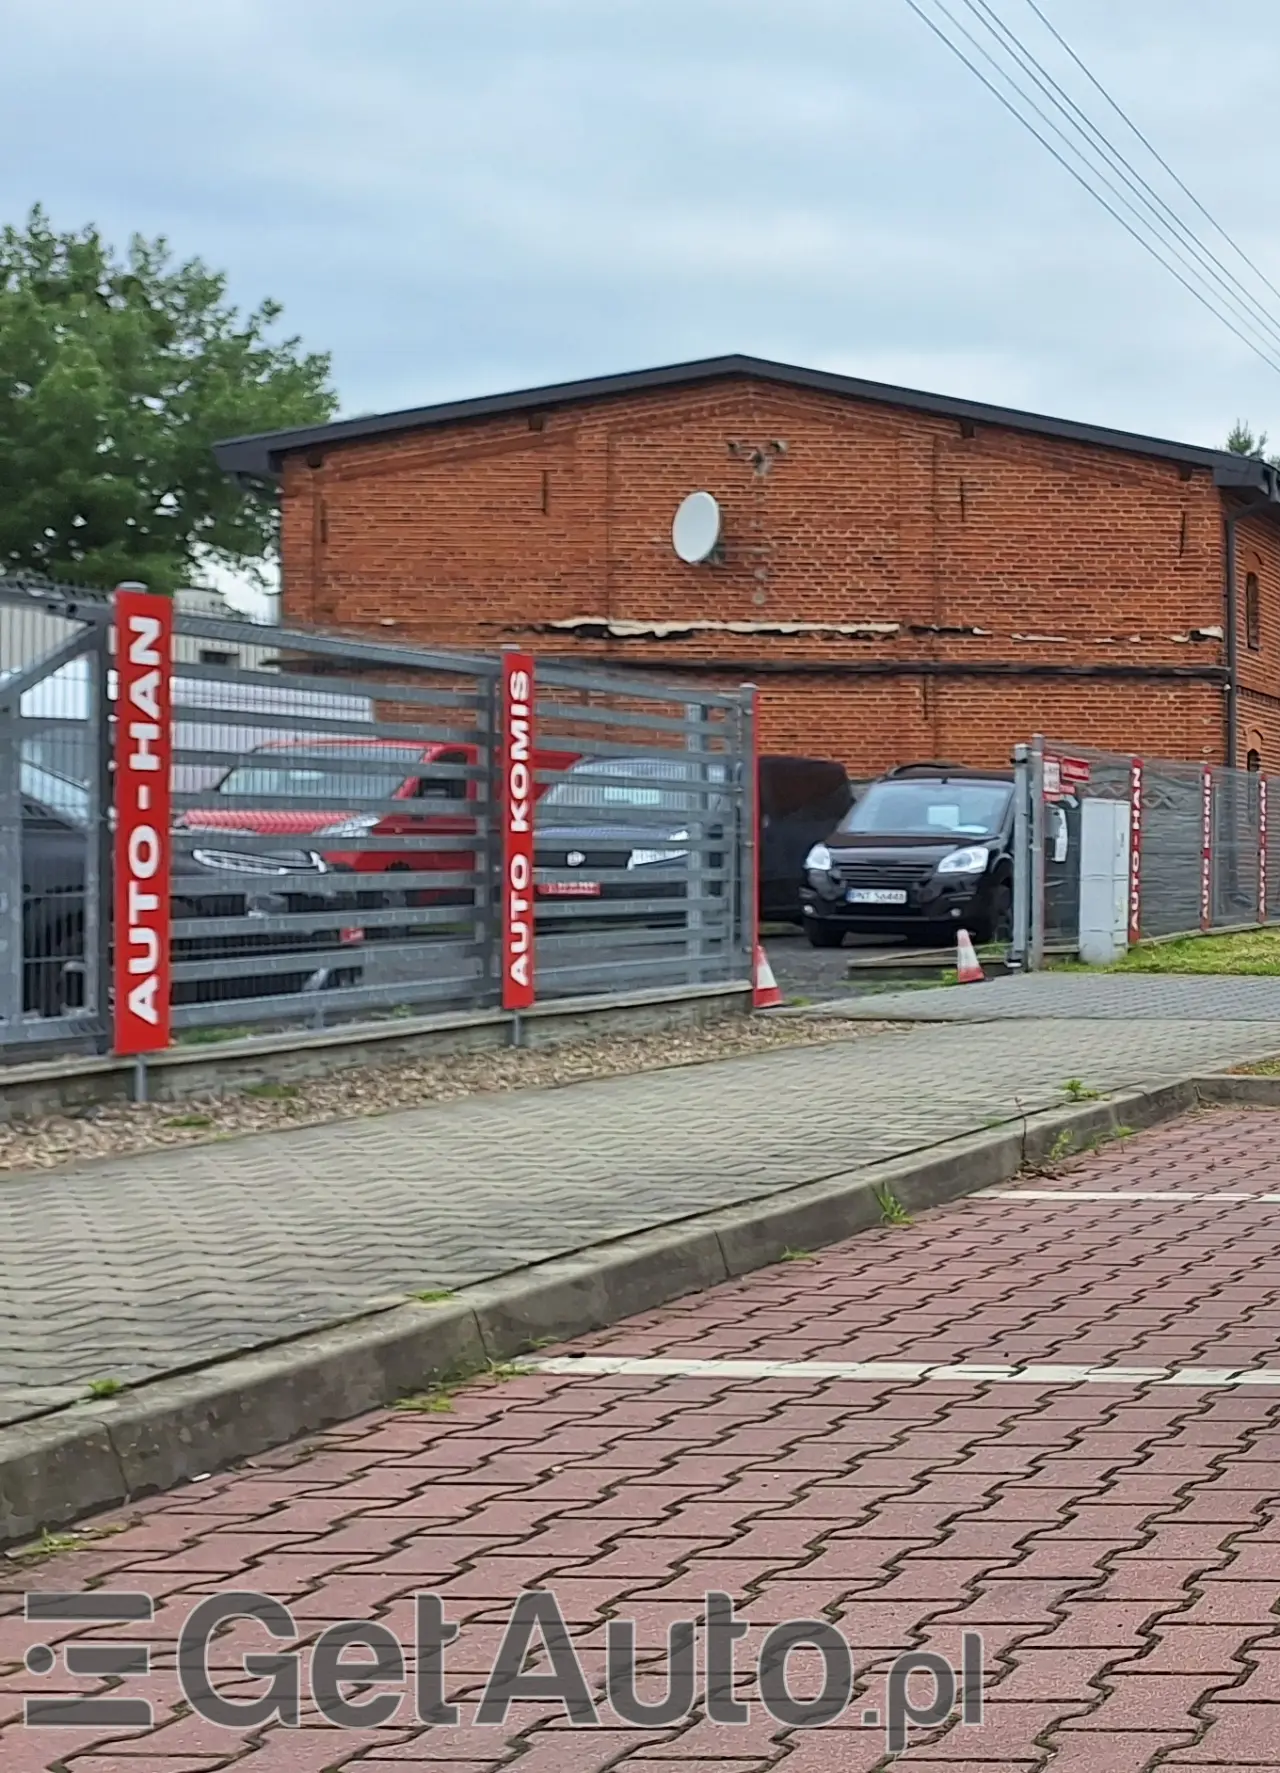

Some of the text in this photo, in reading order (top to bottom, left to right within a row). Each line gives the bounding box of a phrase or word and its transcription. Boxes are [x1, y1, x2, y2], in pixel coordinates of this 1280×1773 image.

[129, 616, 161, 771] HAN
[510, 670, 530, 987] AUTO KOMIS
[1132, 767, 1141, 830] HAN
[1203, 773, 1211, 849] KOMIS
[128, 824, 160, 1025] AUTO
[1131, 850, 1140, 931] AUTO
